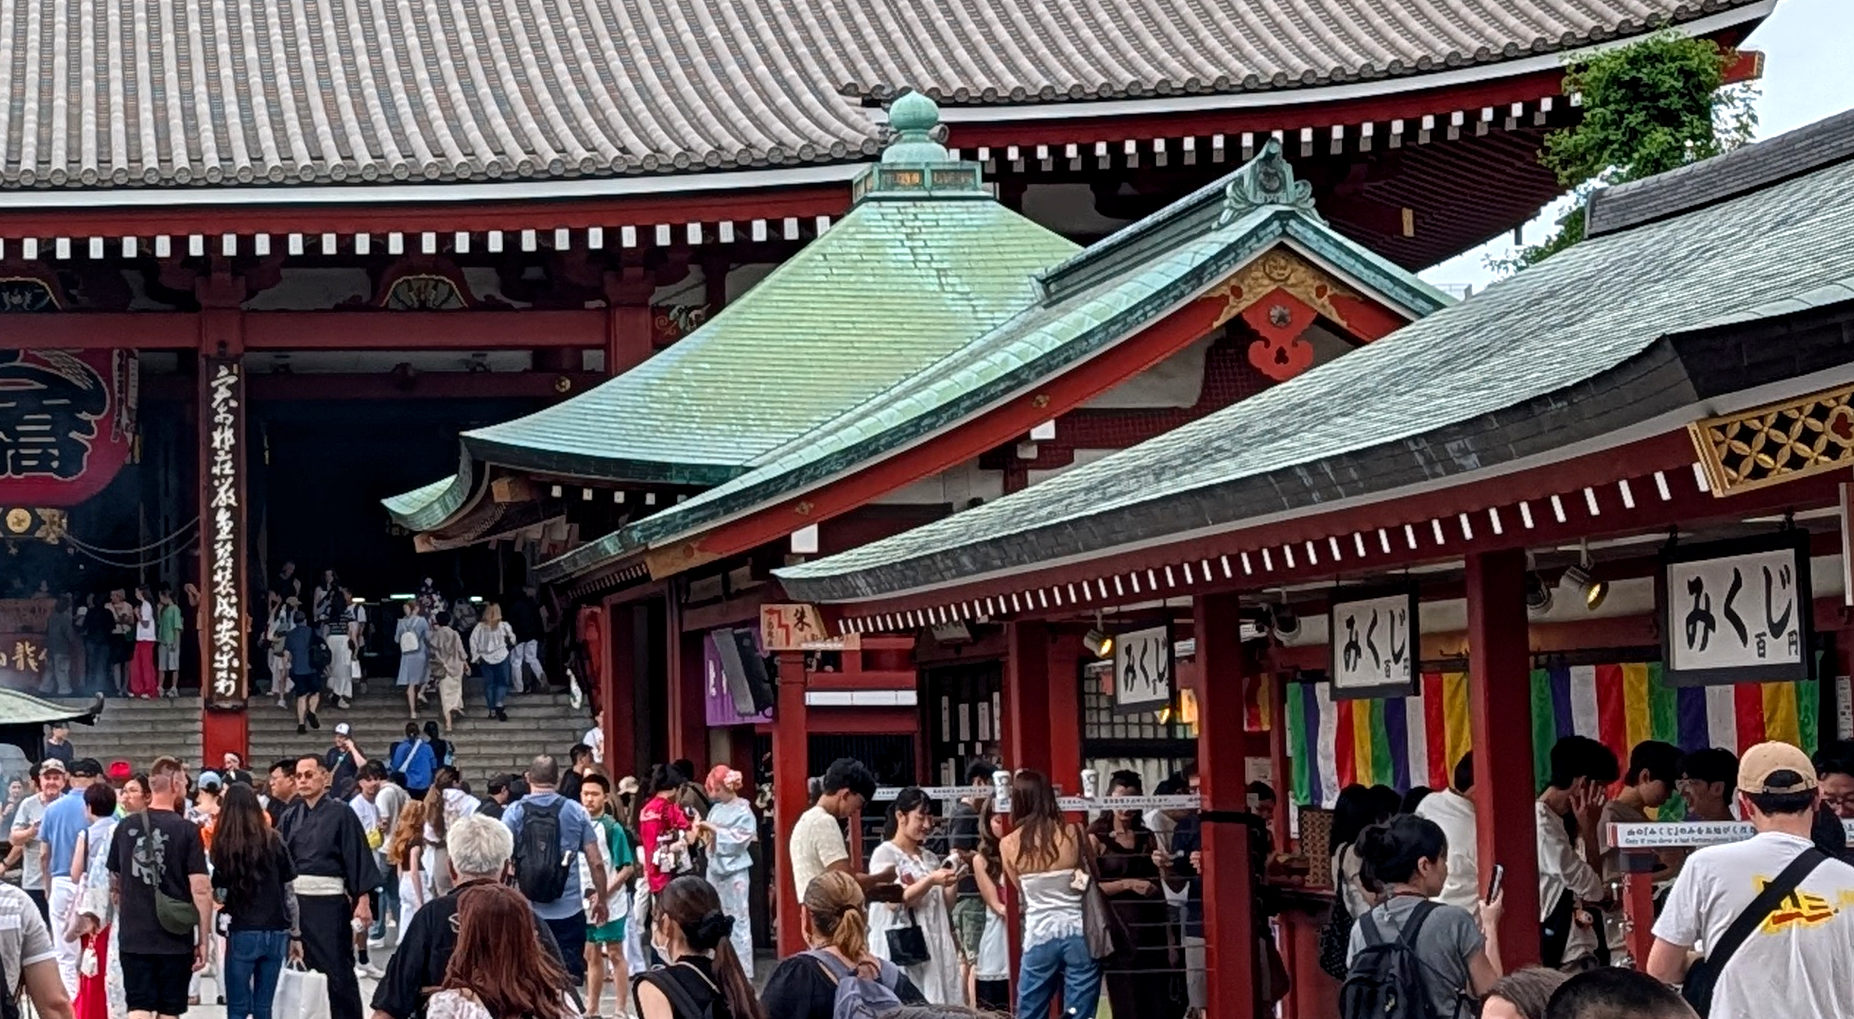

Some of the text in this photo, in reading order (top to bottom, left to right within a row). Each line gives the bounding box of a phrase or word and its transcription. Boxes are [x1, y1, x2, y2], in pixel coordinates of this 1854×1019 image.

[1343, 608, 1406, 672] みくじ
[1685, 564, 1792, 653] みくじ
